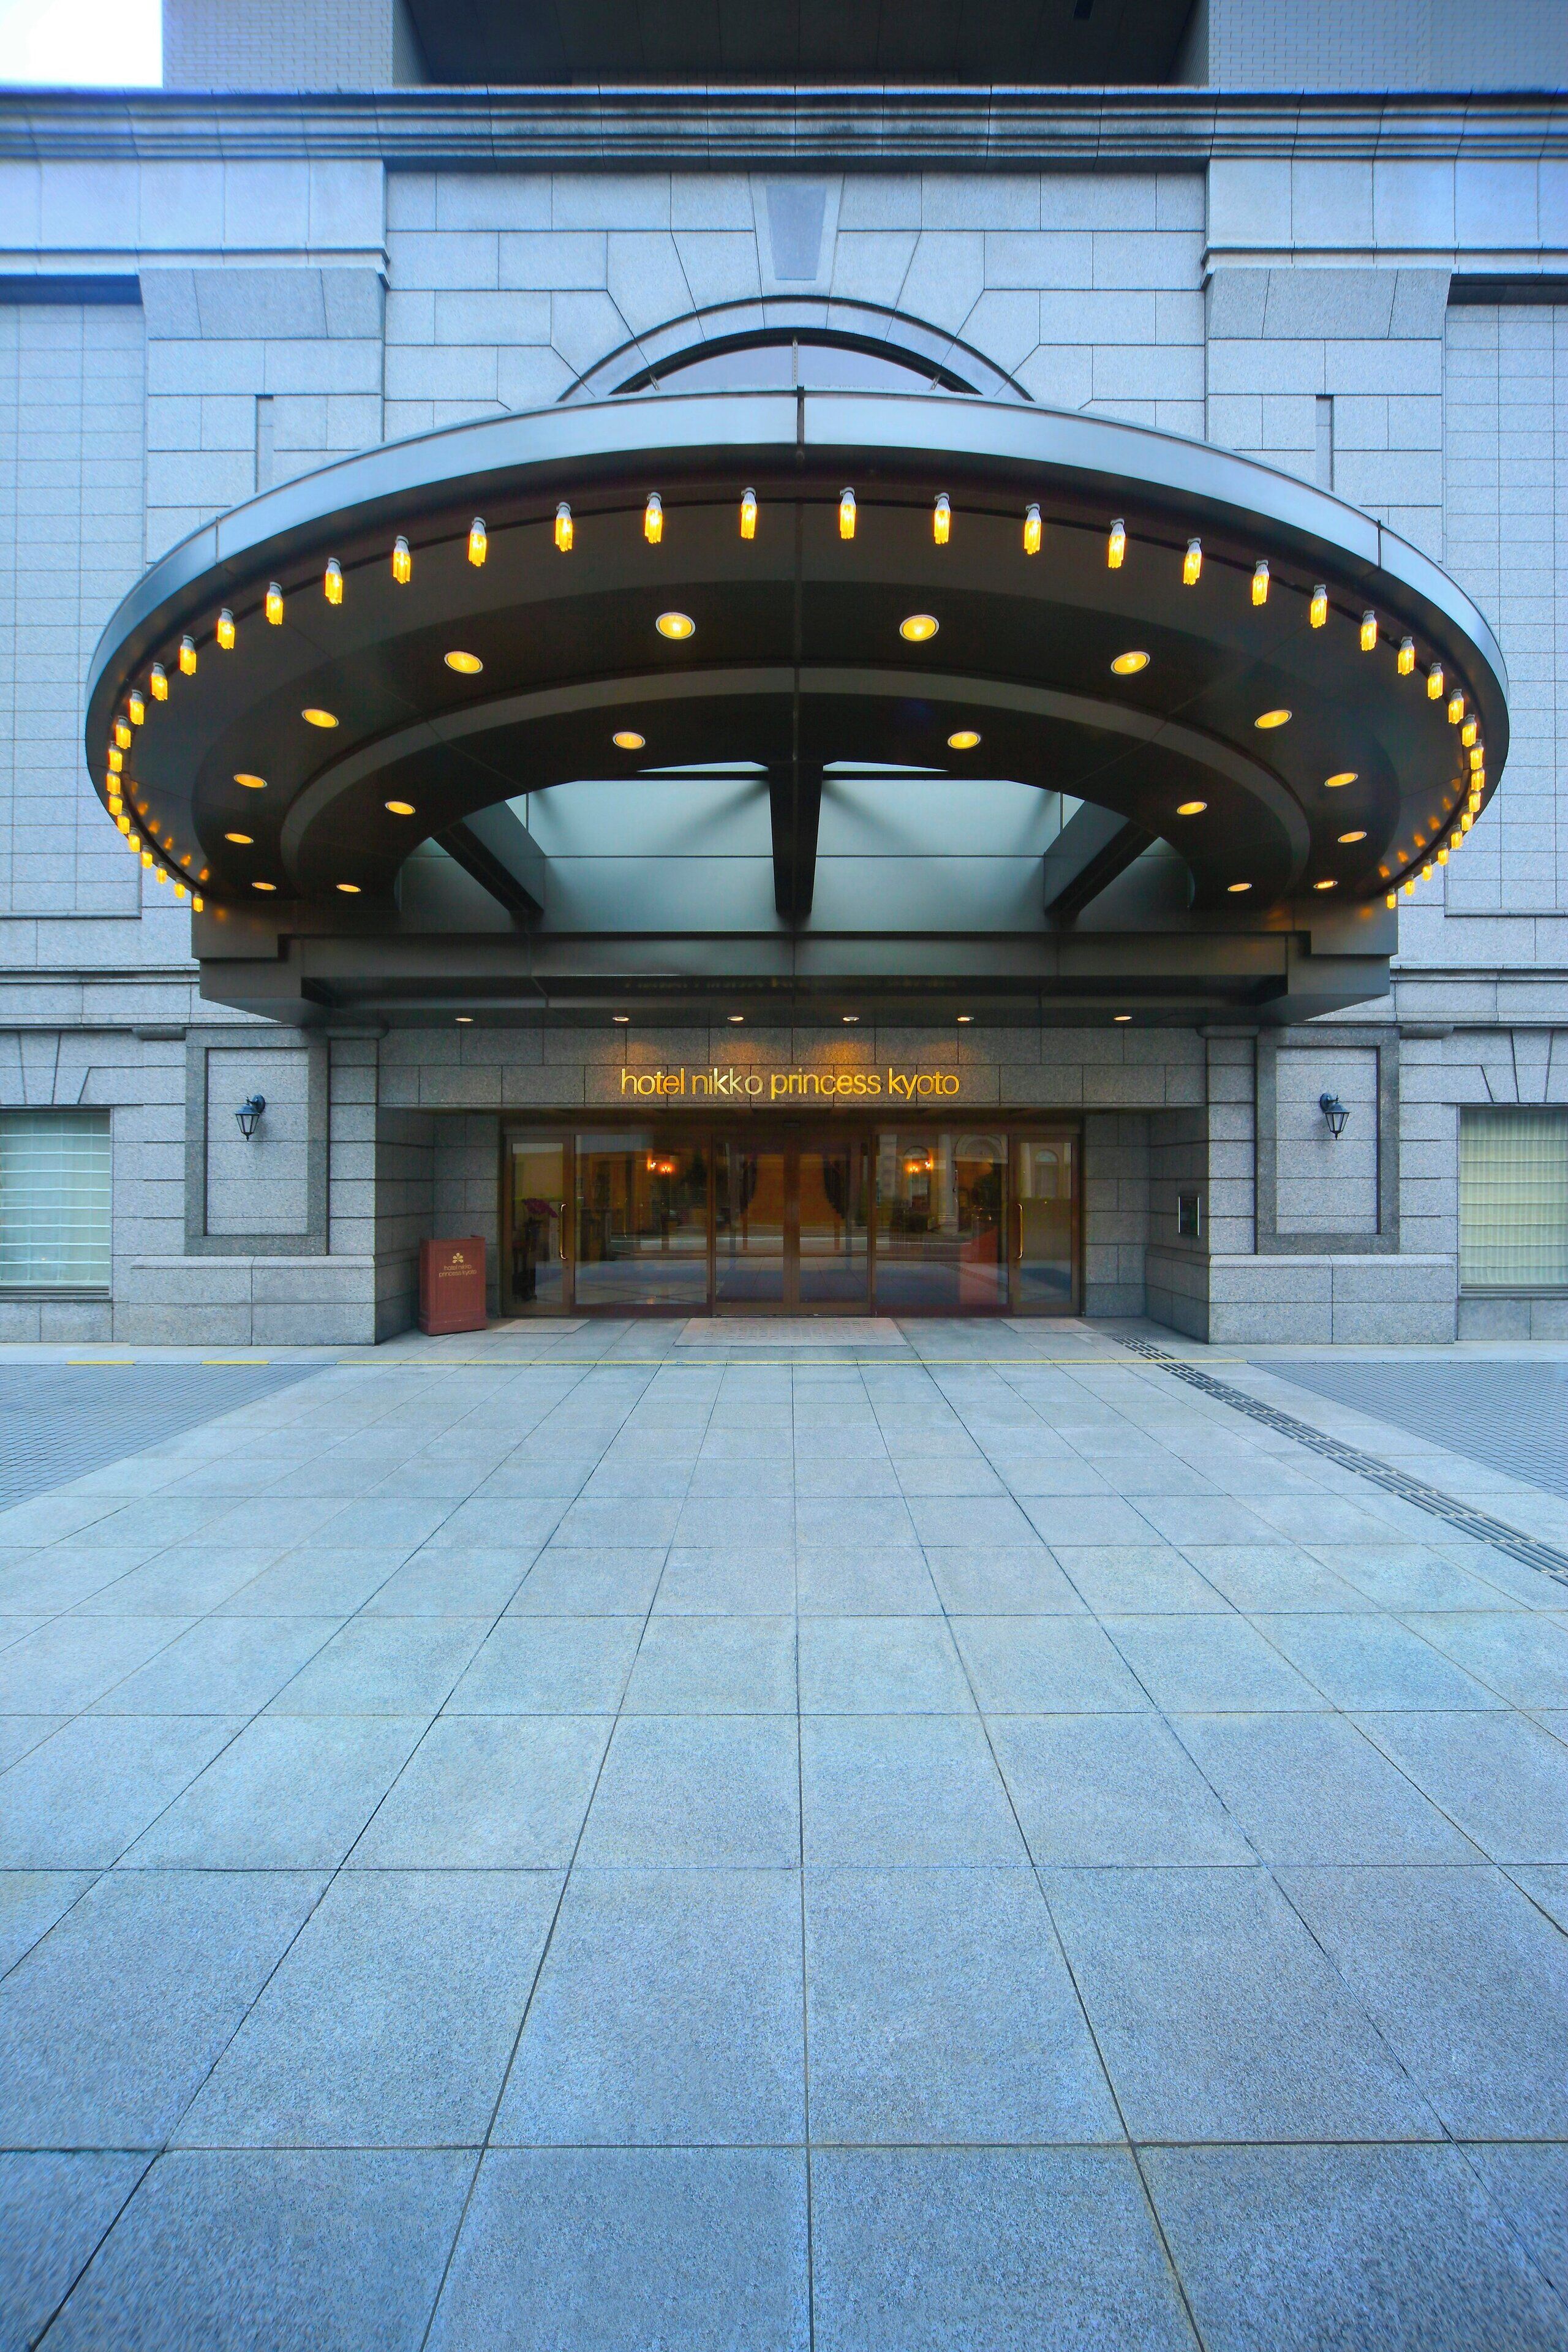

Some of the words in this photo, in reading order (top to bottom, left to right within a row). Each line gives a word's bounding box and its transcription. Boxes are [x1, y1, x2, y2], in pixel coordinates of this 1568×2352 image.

[621, 1068, 685, 1095] hotel
[692, 1068, 763, 1095] nikko
[771, 1068, 882, 1100] princess
[889, 1068, 960, 1100] kyoto
